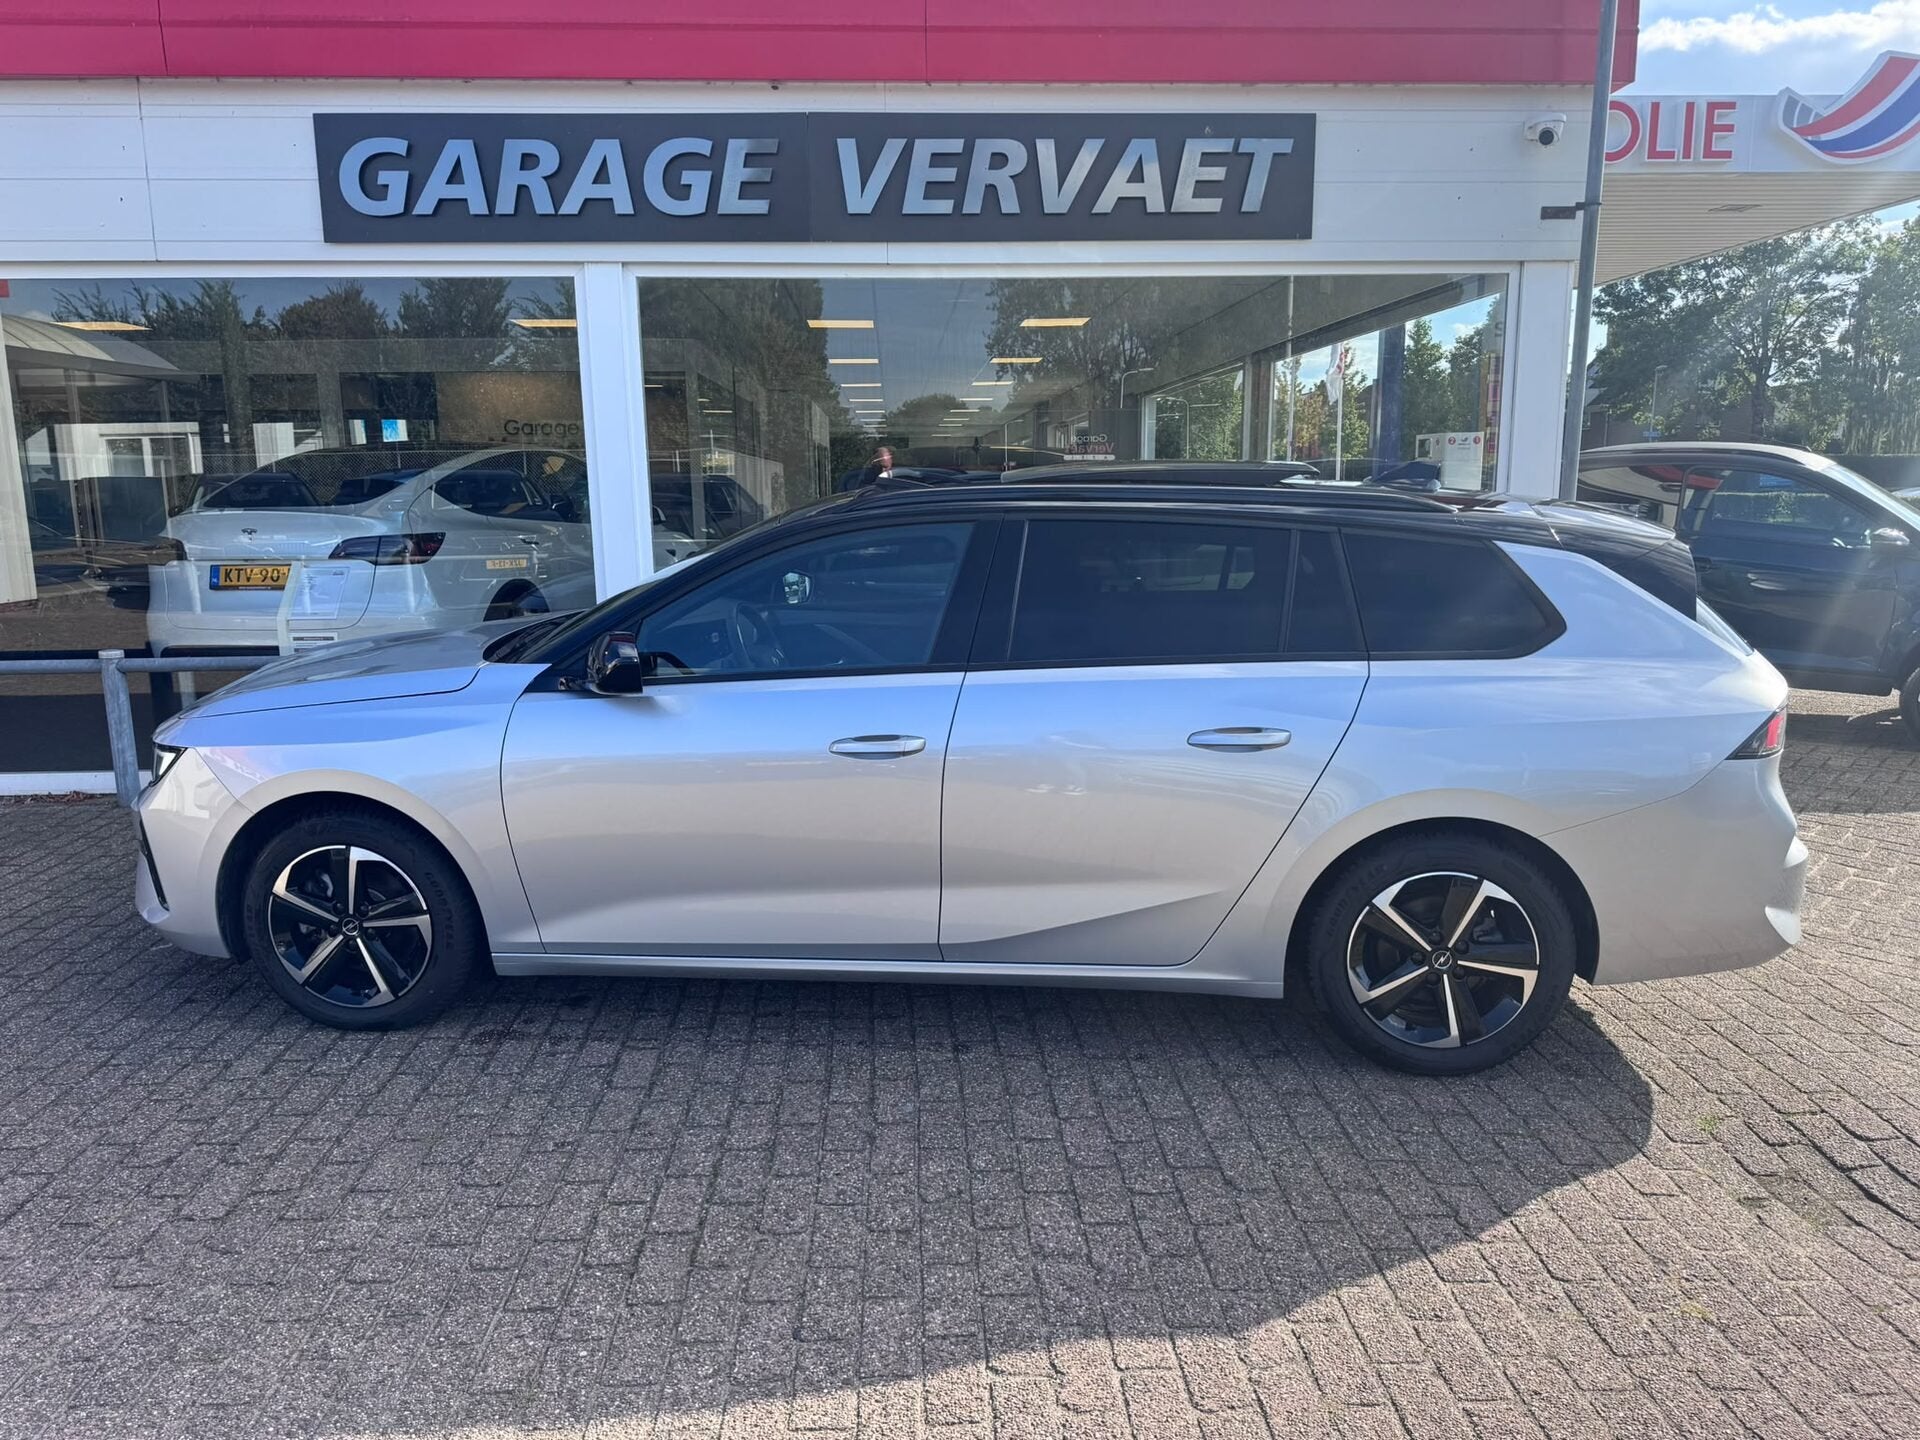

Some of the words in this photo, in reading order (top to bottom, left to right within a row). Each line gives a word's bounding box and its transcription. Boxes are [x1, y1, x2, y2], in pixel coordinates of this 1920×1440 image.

[338, 137, 779, 218] GARAGE
[836, 137, 1295, 216] VERVAET
[504, 419, 579, 438] Garage
[223, 567, 290, 583] KTV-90-
